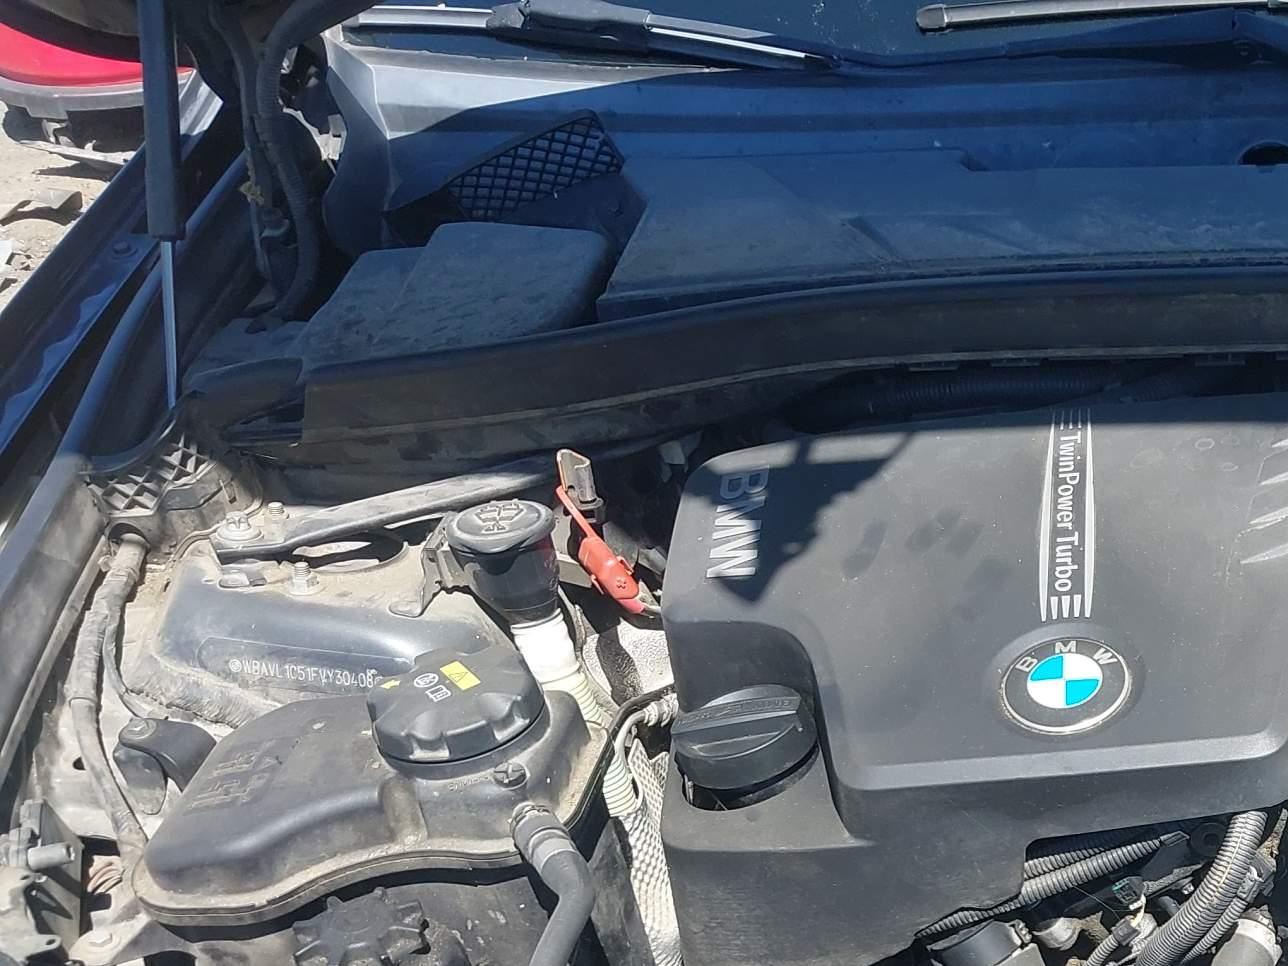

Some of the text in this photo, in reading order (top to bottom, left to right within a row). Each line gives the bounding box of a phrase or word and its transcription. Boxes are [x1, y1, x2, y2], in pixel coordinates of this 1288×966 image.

[706, 465, 769, 578] BMW
[1054, 431, 1081, 592] TwinPower Turbo
[1015, 640, 1118, 673] BMW
